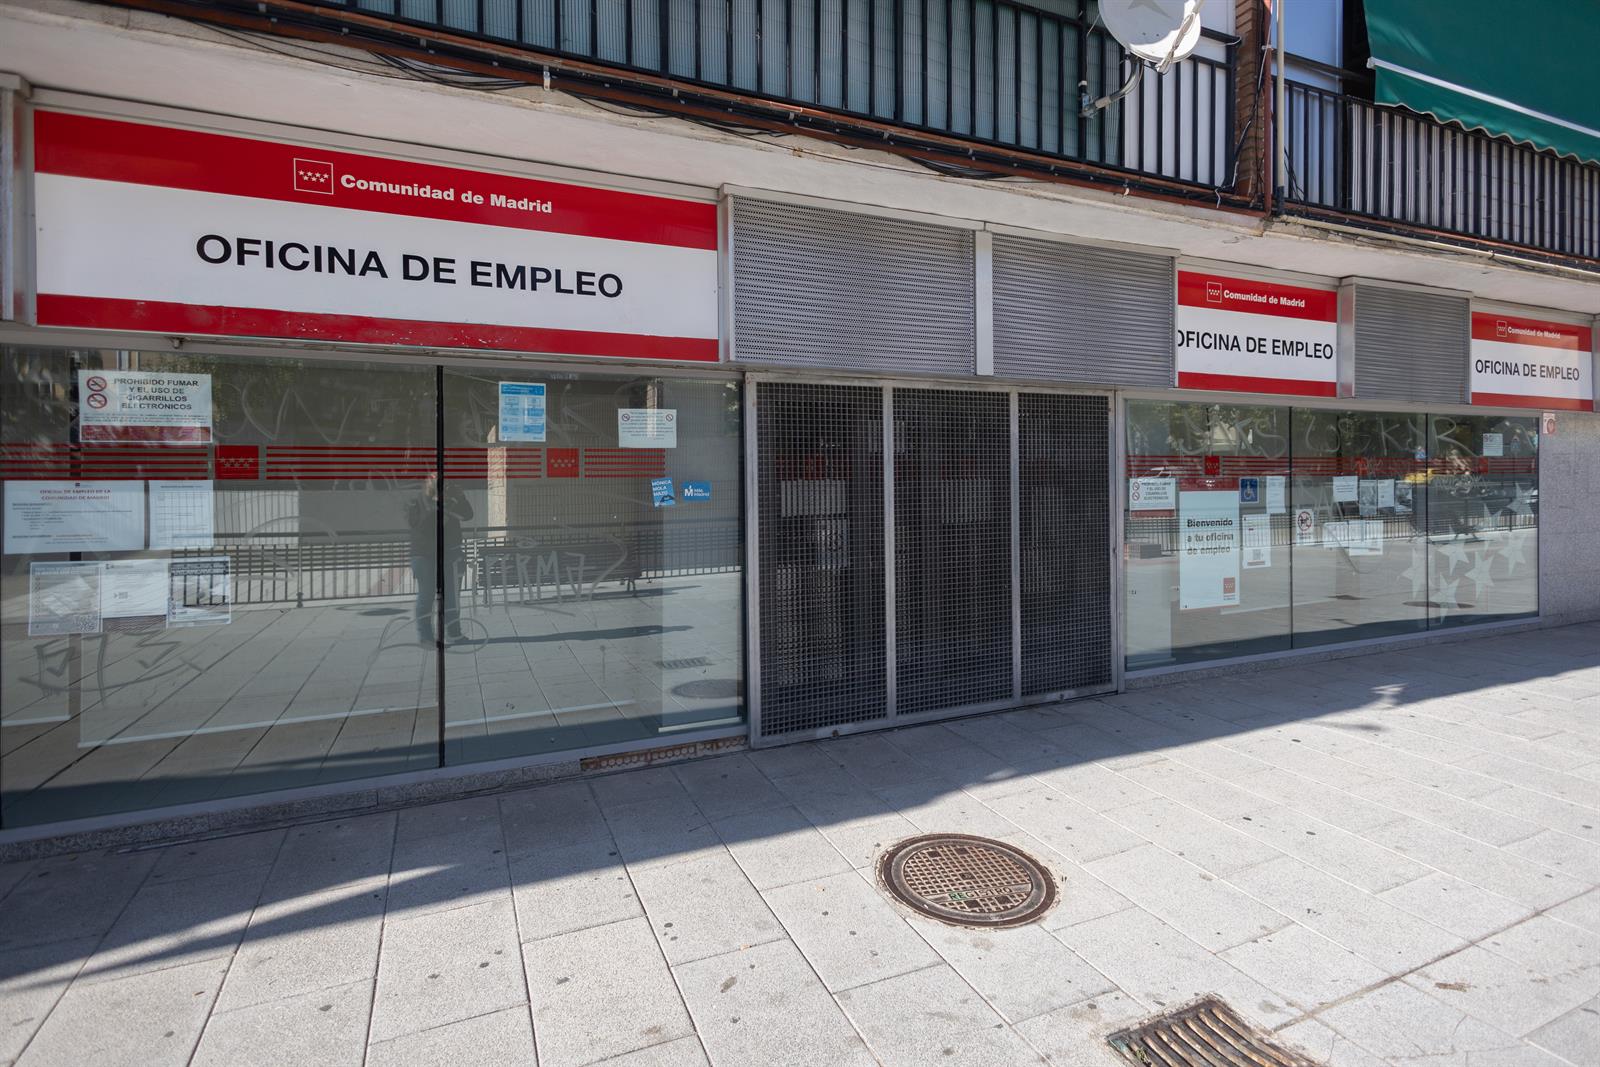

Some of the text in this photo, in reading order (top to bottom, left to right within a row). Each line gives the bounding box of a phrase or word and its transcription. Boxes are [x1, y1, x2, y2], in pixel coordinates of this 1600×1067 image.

[340, 174, 553, 214] Comunidad de Madrid
[195, 234, 623, 298] OFICINA DE EMPLEO
[1223, 289, 1306, 308] Comunidad de Madrid
[1507, 326, 1561, 339] Comunidad de Madrid
[1246, 336, 1267, 354] DE
[1272, 339, 1334, 360] EMPLEO
[1475, 359, 1580, 381] OFICINA DE EMPLEO
[113, 378, 165, 386] PROHIBIDO
[126, 394, 188, 402] CIGARRILLOS
[1186, 518, 1233, 528] Bienvenido
[1194, 533, 1204, 542] tu
[1205, 532, 1234, 542] oficina
[1187, 546, 1231, 556] de empleo
